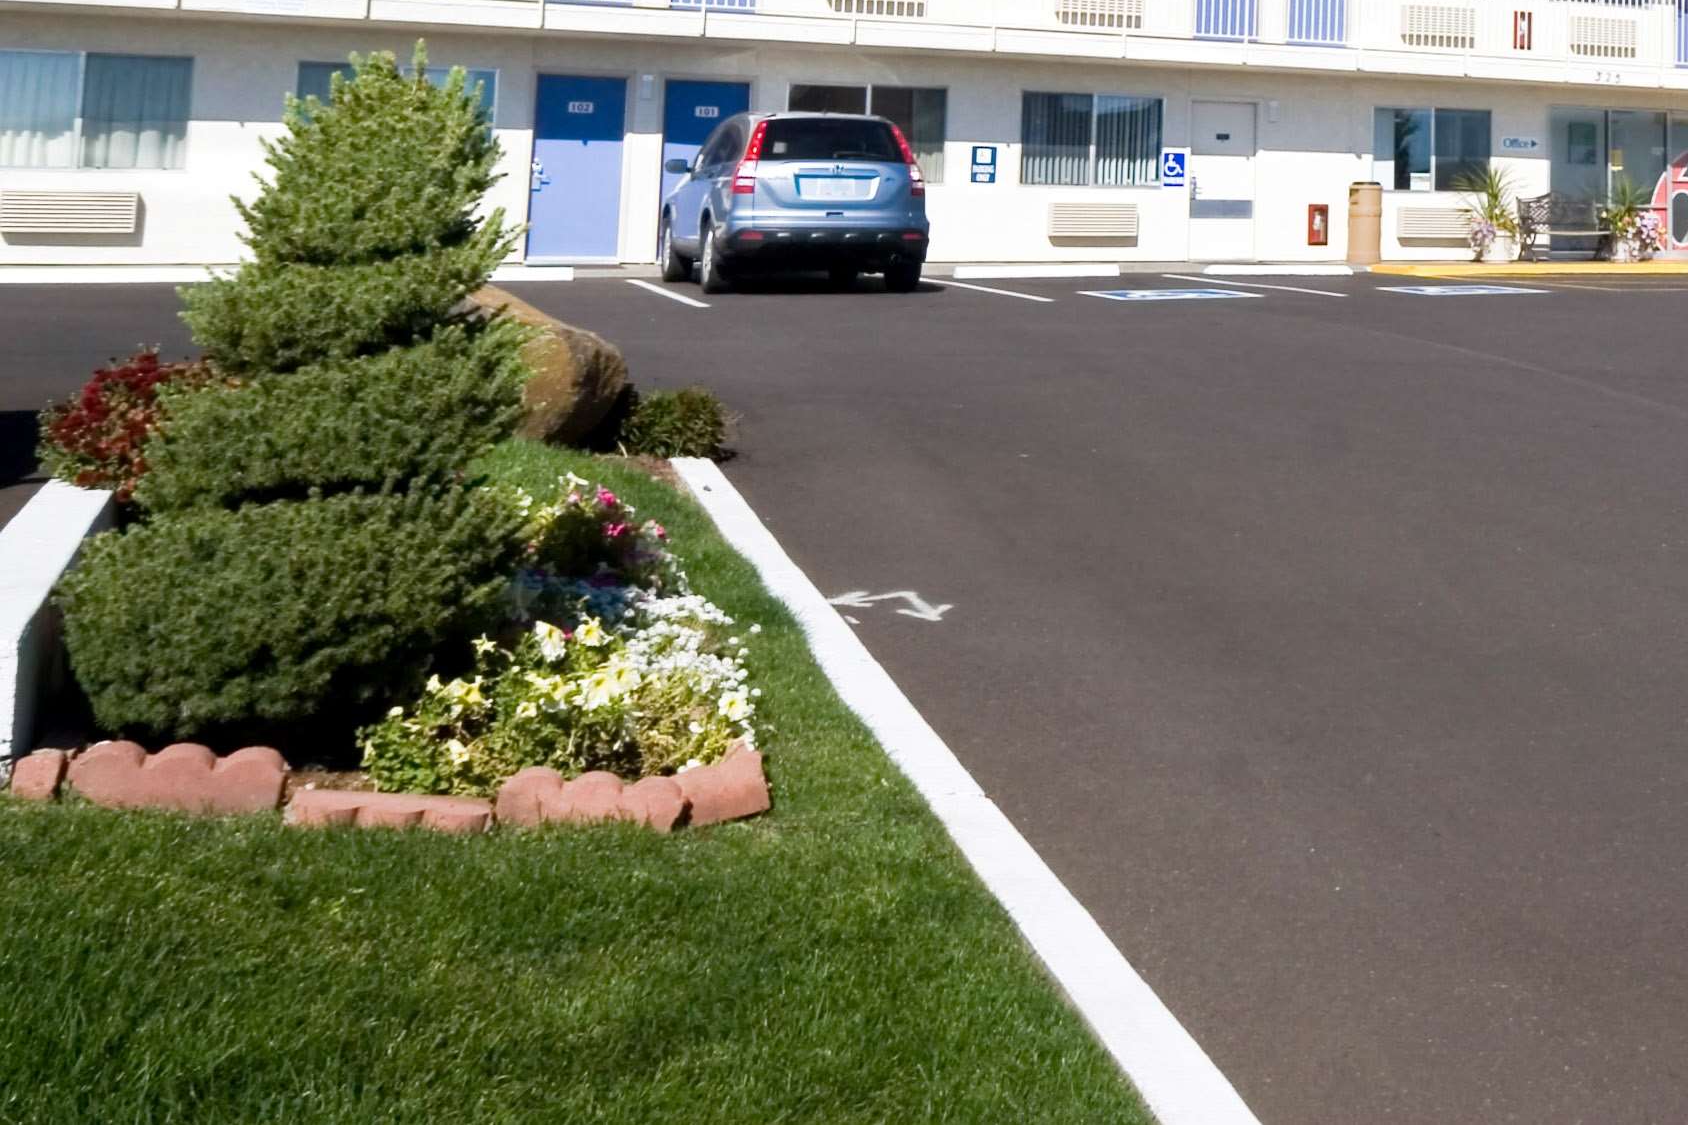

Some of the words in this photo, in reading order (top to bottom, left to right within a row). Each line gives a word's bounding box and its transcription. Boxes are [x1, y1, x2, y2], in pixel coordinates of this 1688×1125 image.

[571, 103, 590, 112] 102
[699, 107, 716, 116] 101
[1503, 138, 1529, 148] Office
